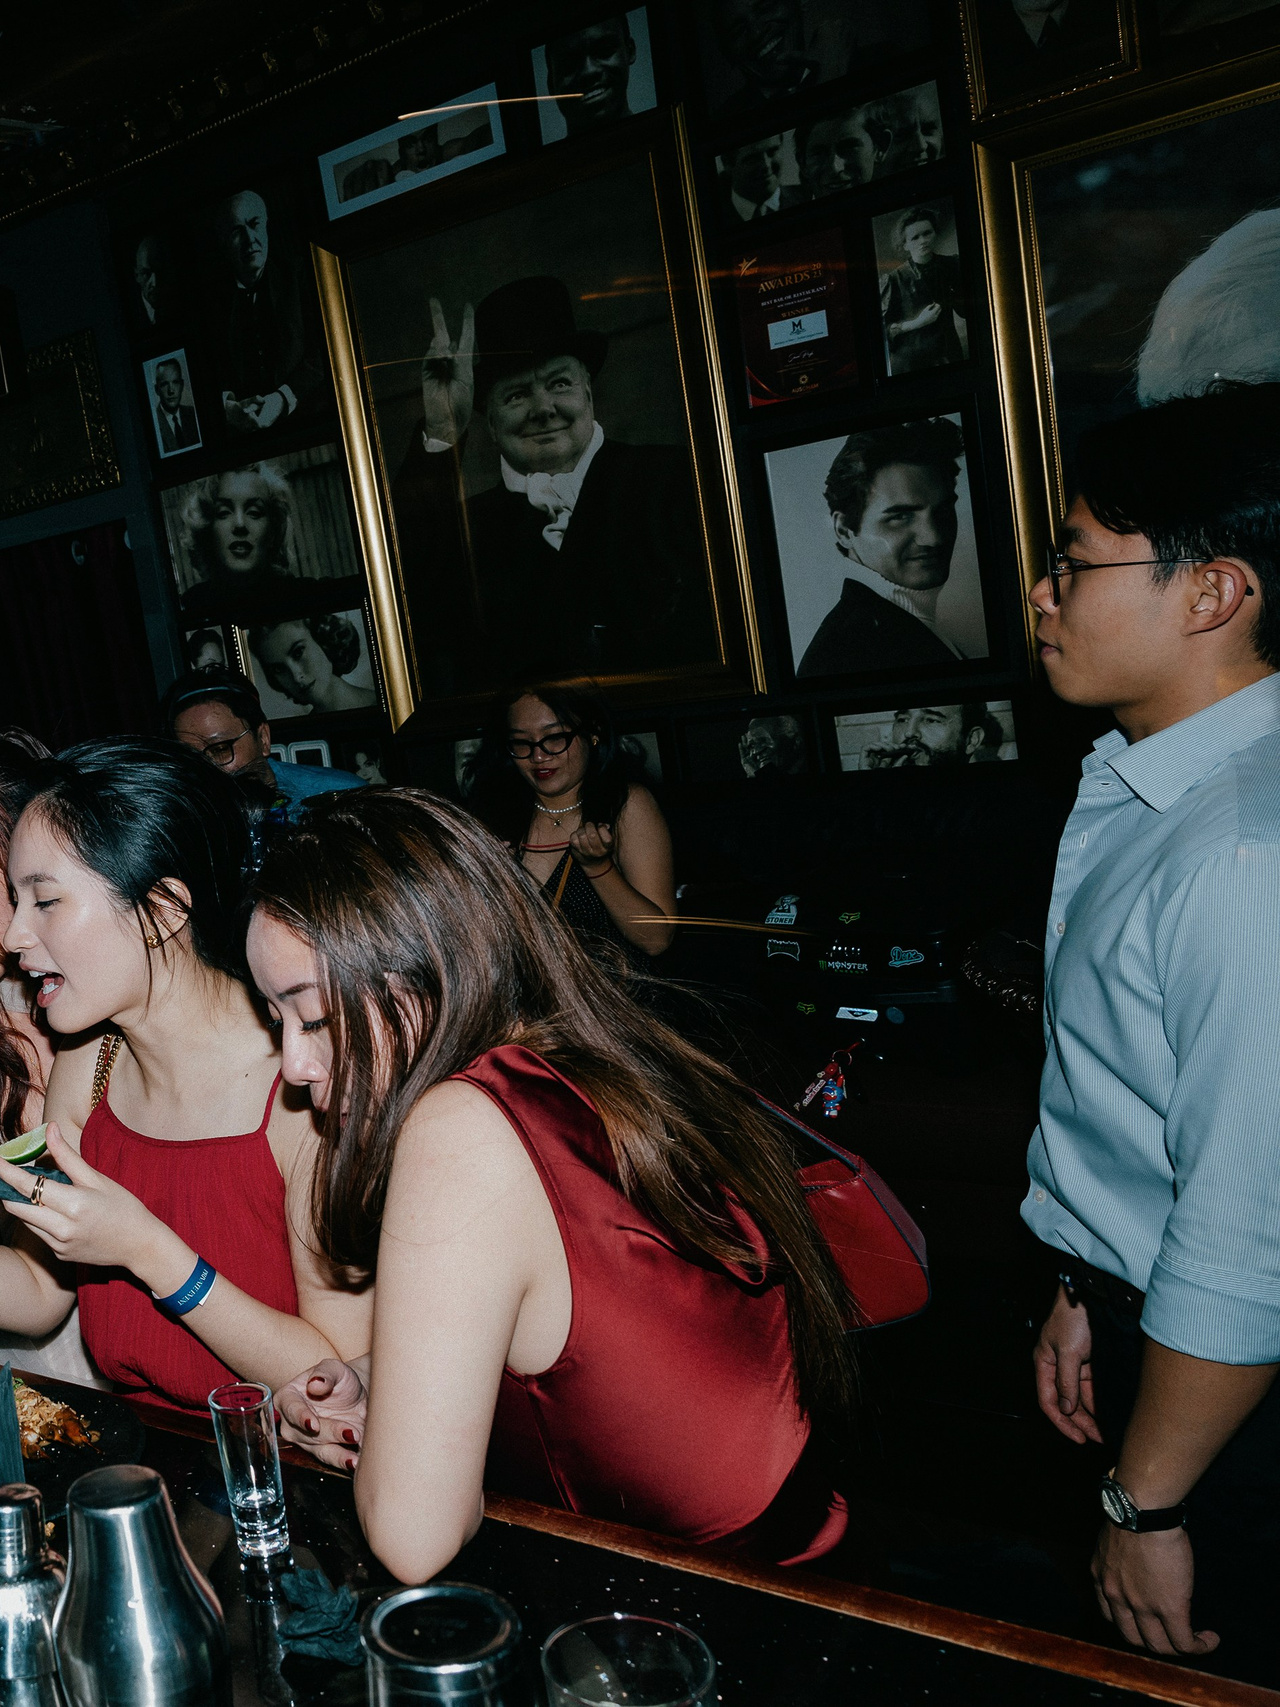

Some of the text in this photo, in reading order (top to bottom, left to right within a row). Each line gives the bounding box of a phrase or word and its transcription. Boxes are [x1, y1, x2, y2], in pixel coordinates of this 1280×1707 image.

[758, 271, 811, 293] AWARDS
[827, 961, 868, 971] MONSTER
[177, 1290, 196, 1306] EVENT
